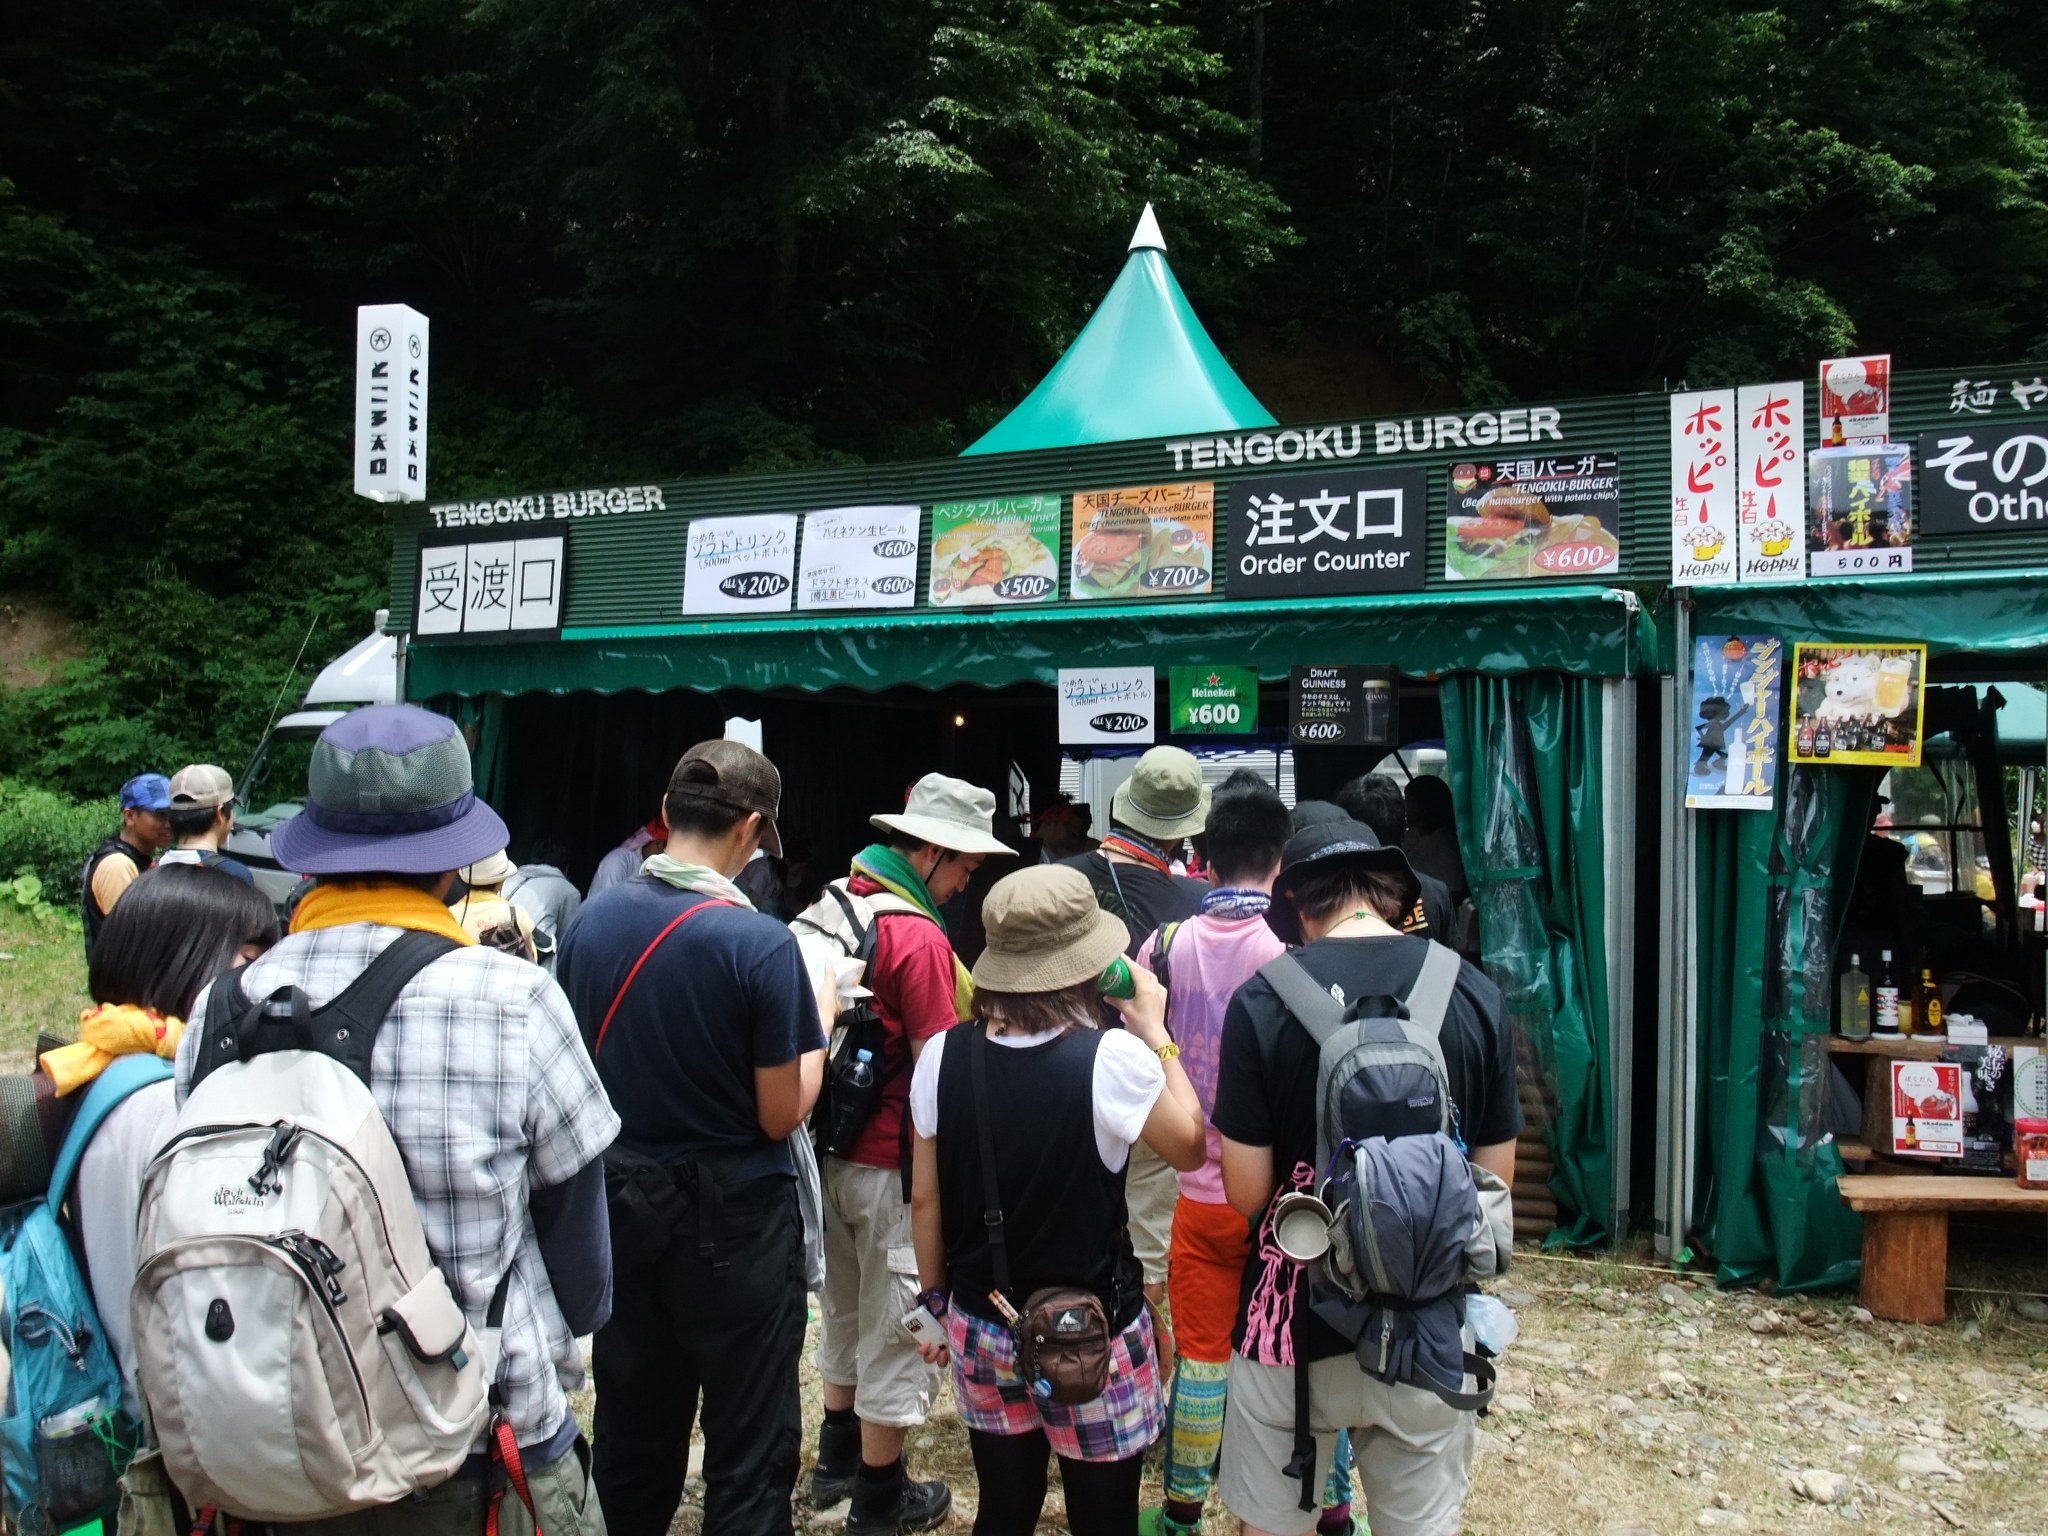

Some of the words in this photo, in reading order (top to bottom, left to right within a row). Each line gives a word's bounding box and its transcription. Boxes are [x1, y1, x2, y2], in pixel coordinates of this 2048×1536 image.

[1165, 424, 1361, 471] TENGOKU
[1375, 406, 1563, 455] BURGER
[1684, 397, 1727, 525] ホッピー
[1752, 390, 1795, 519] ホッピー
[1925, 434, 2048, 491] その
[1496, 455, 1617, 481] 天国バーガー
[429, 496, 545, 527] TENGOKU
[553, 485, 666, 520] BURGER
[938, 496, 1057, 519] ベジタブルバーガー
[1082, 485, 1212, 508] 天国チーズバーガー
[1564, 492, 1592, 503] potato
[1593, 489, 1619, 501] chips)
[1968, 489, 2048, 523] Oth
[1244, 488, 1404, 548] 注文口
[823, 524, 907, 538] ハイネケン生ビール
[691, 530, 786, 558] ソフトドリンク
[1240, 554, 1307, 576] Order
[1313, 549, 1411, 572] Counter
[424, 558, 557, 613] 受渡口
[721, 579, 736, 589] ALL
[812, 577, 869, 589] ドラフトギネス
[1301, 679, 1346, 689] GUINNESS
[1310, 668, 1338, 678] DRAFT
[1064, 678, 1143, 698] ソフトドリンク
[1192, 688, 1236, 698] Heineken
[1092, 717, 1105, 725] ALL
[1189, 704, 1240, 725] ¥600
